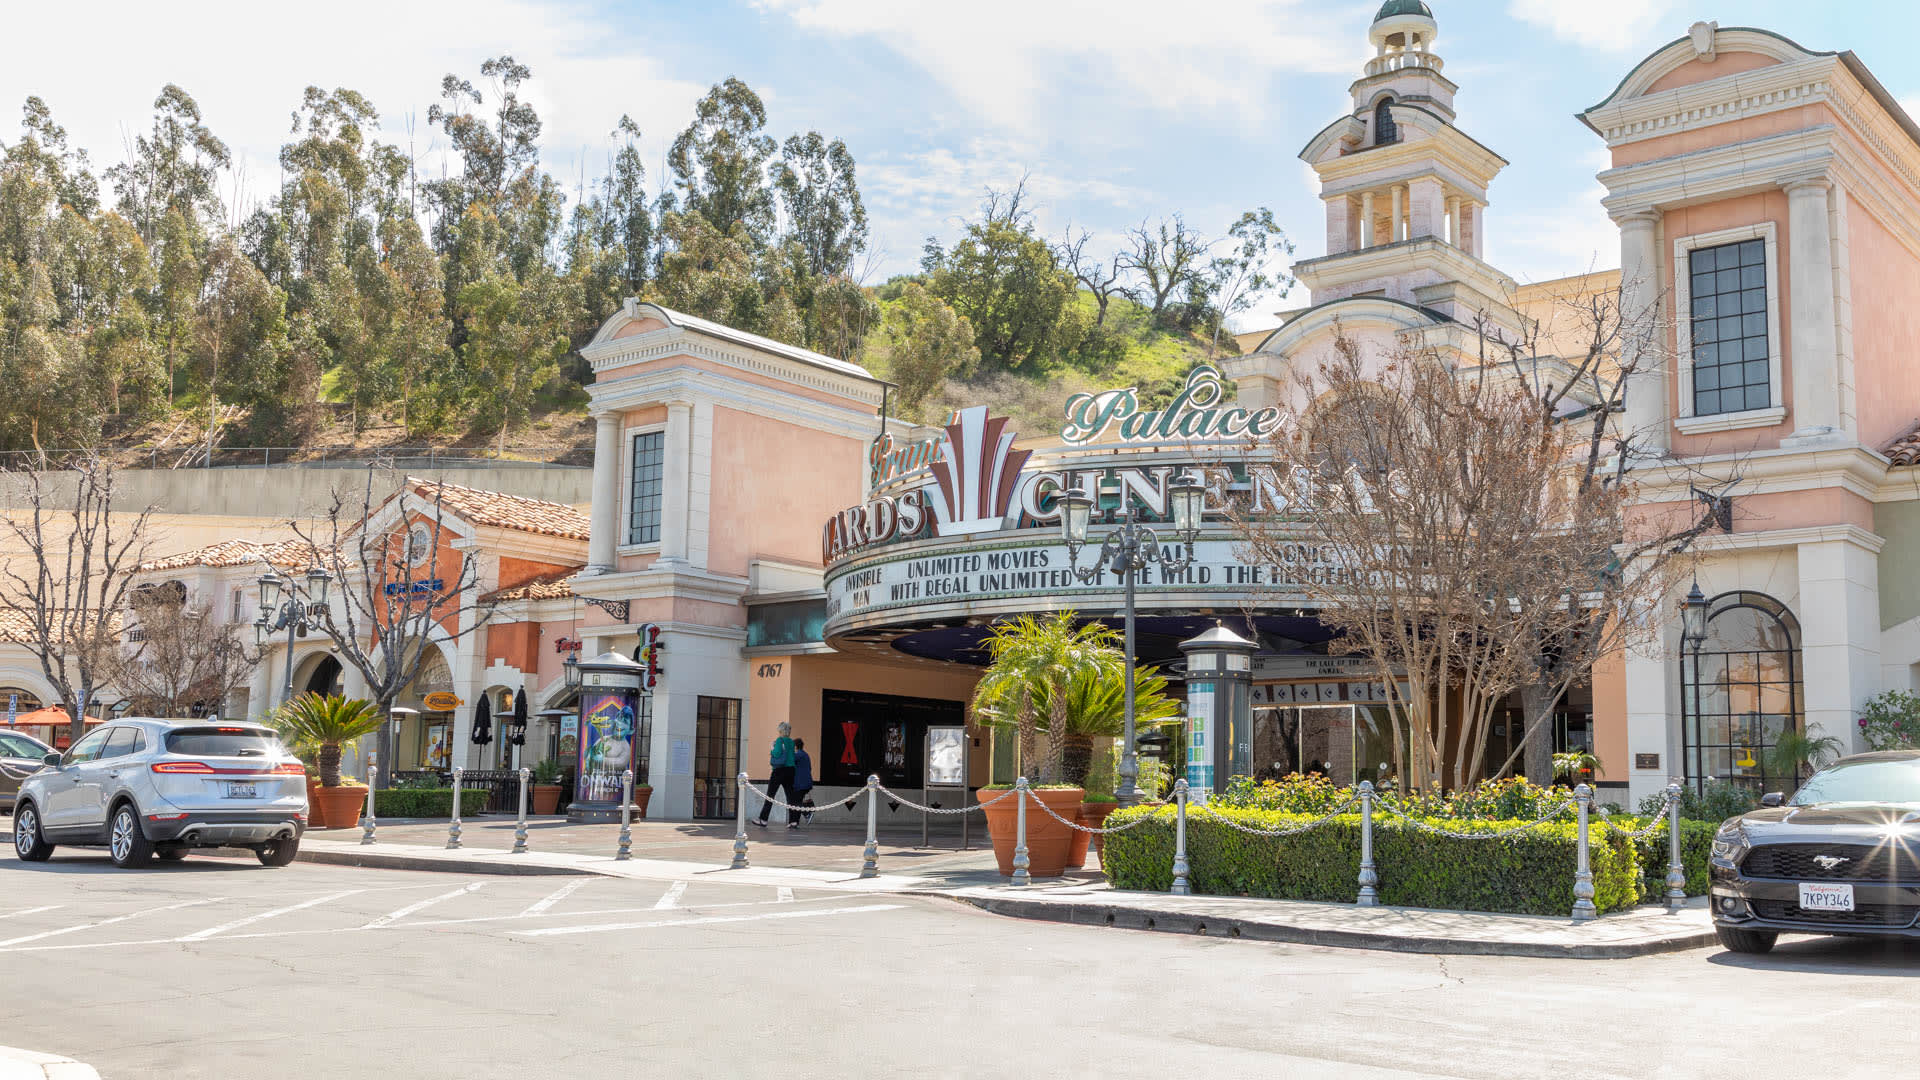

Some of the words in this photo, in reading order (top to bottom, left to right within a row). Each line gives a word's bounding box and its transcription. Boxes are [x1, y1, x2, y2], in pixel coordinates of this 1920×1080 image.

[1059, 365, 1289, 446] Palace
[907, 554, 982, 579] UNLIMITED
[987, 549, 1050, 573] MOVIES
[845, 567, 883, 592] INVISIBLE
[891, 580, 920, 601] WITH
[925, 573, 970, 598] REGAL
[979, 567, 1072, 592] UNLIMITED
[1160, 565, 1211, 585] WILD
[1223, 565, 1263, 584] THE
[852, 590, 871, 609] MAN
[757, 663, 783, 679] 4767
[1803, 892, 1850, 907] 7KPY346
